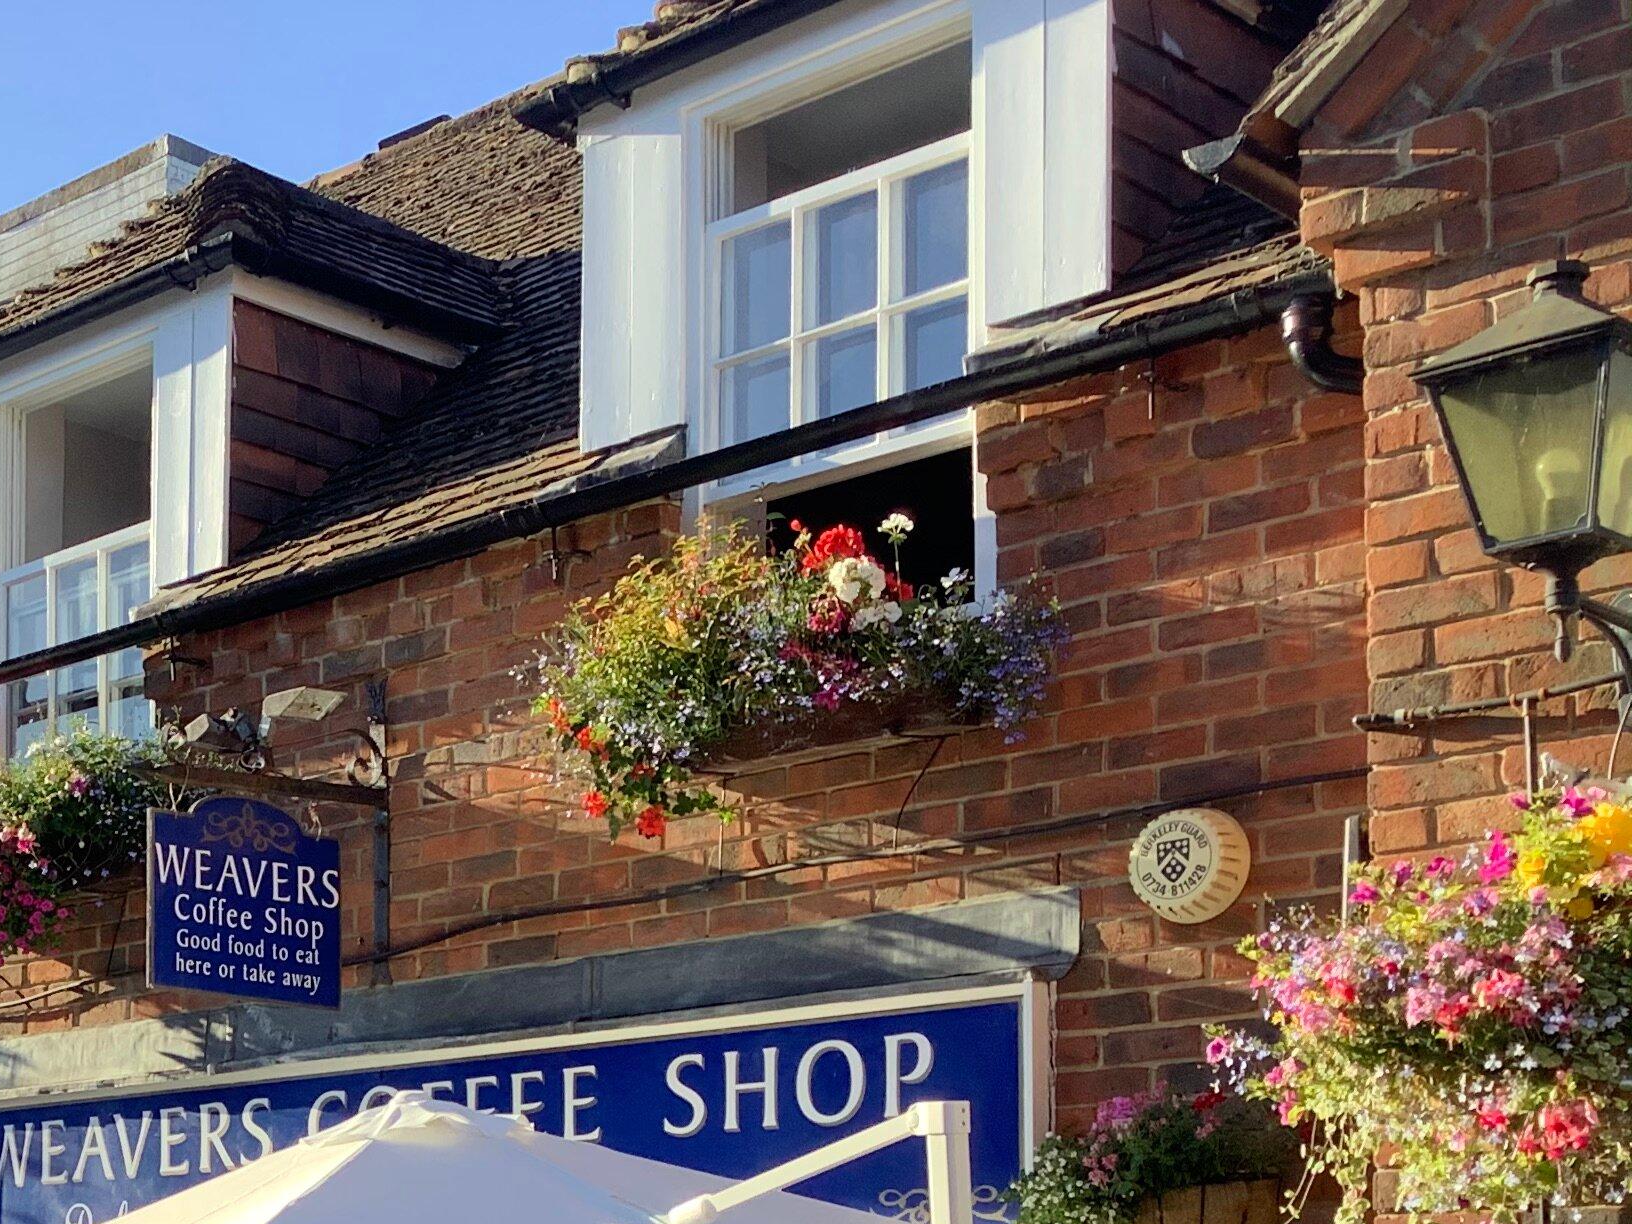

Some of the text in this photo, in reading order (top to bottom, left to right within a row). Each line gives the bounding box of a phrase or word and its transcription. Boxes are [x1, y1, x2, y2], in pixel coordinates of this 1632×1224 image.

[1140, 822, 1208, 857] BERKELEY GUARD
[154, 842, 340, 909] WEAVERS
[1142, 864, 1207, 896] 0734 811428
[173, 893, 324, 949] Coffee Shop
[176, 928, 320, 965] Good food to eat
[175, 952, 321, 996] here or take away
[663, 1031, 935, 1138] SHOP
